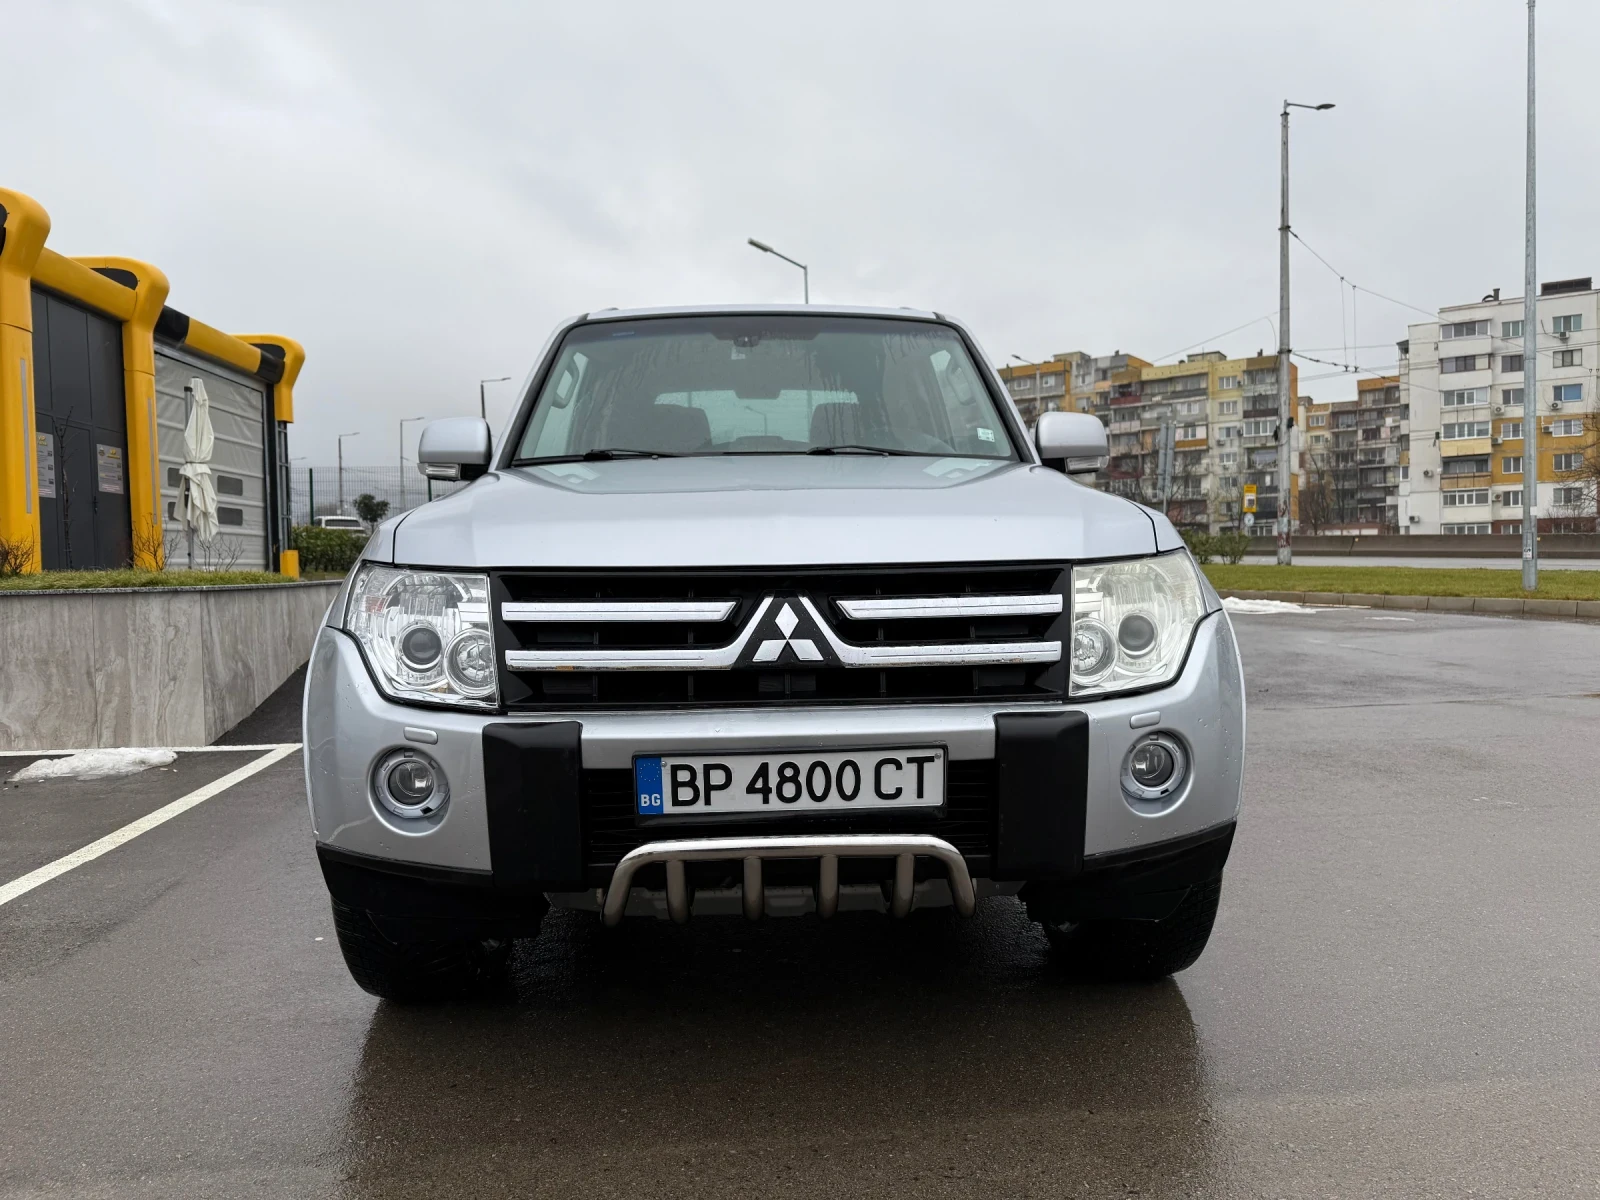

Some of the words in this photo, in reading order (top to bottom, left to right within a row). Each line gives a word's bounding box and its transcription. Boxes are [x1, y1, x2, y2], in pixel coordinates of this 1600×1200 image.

[670, 763, 733, 807] BP
[745, 759, 861, 805] 4800
[873, 755, 936, 801] CT
[640, 794, 661, 807] BG
